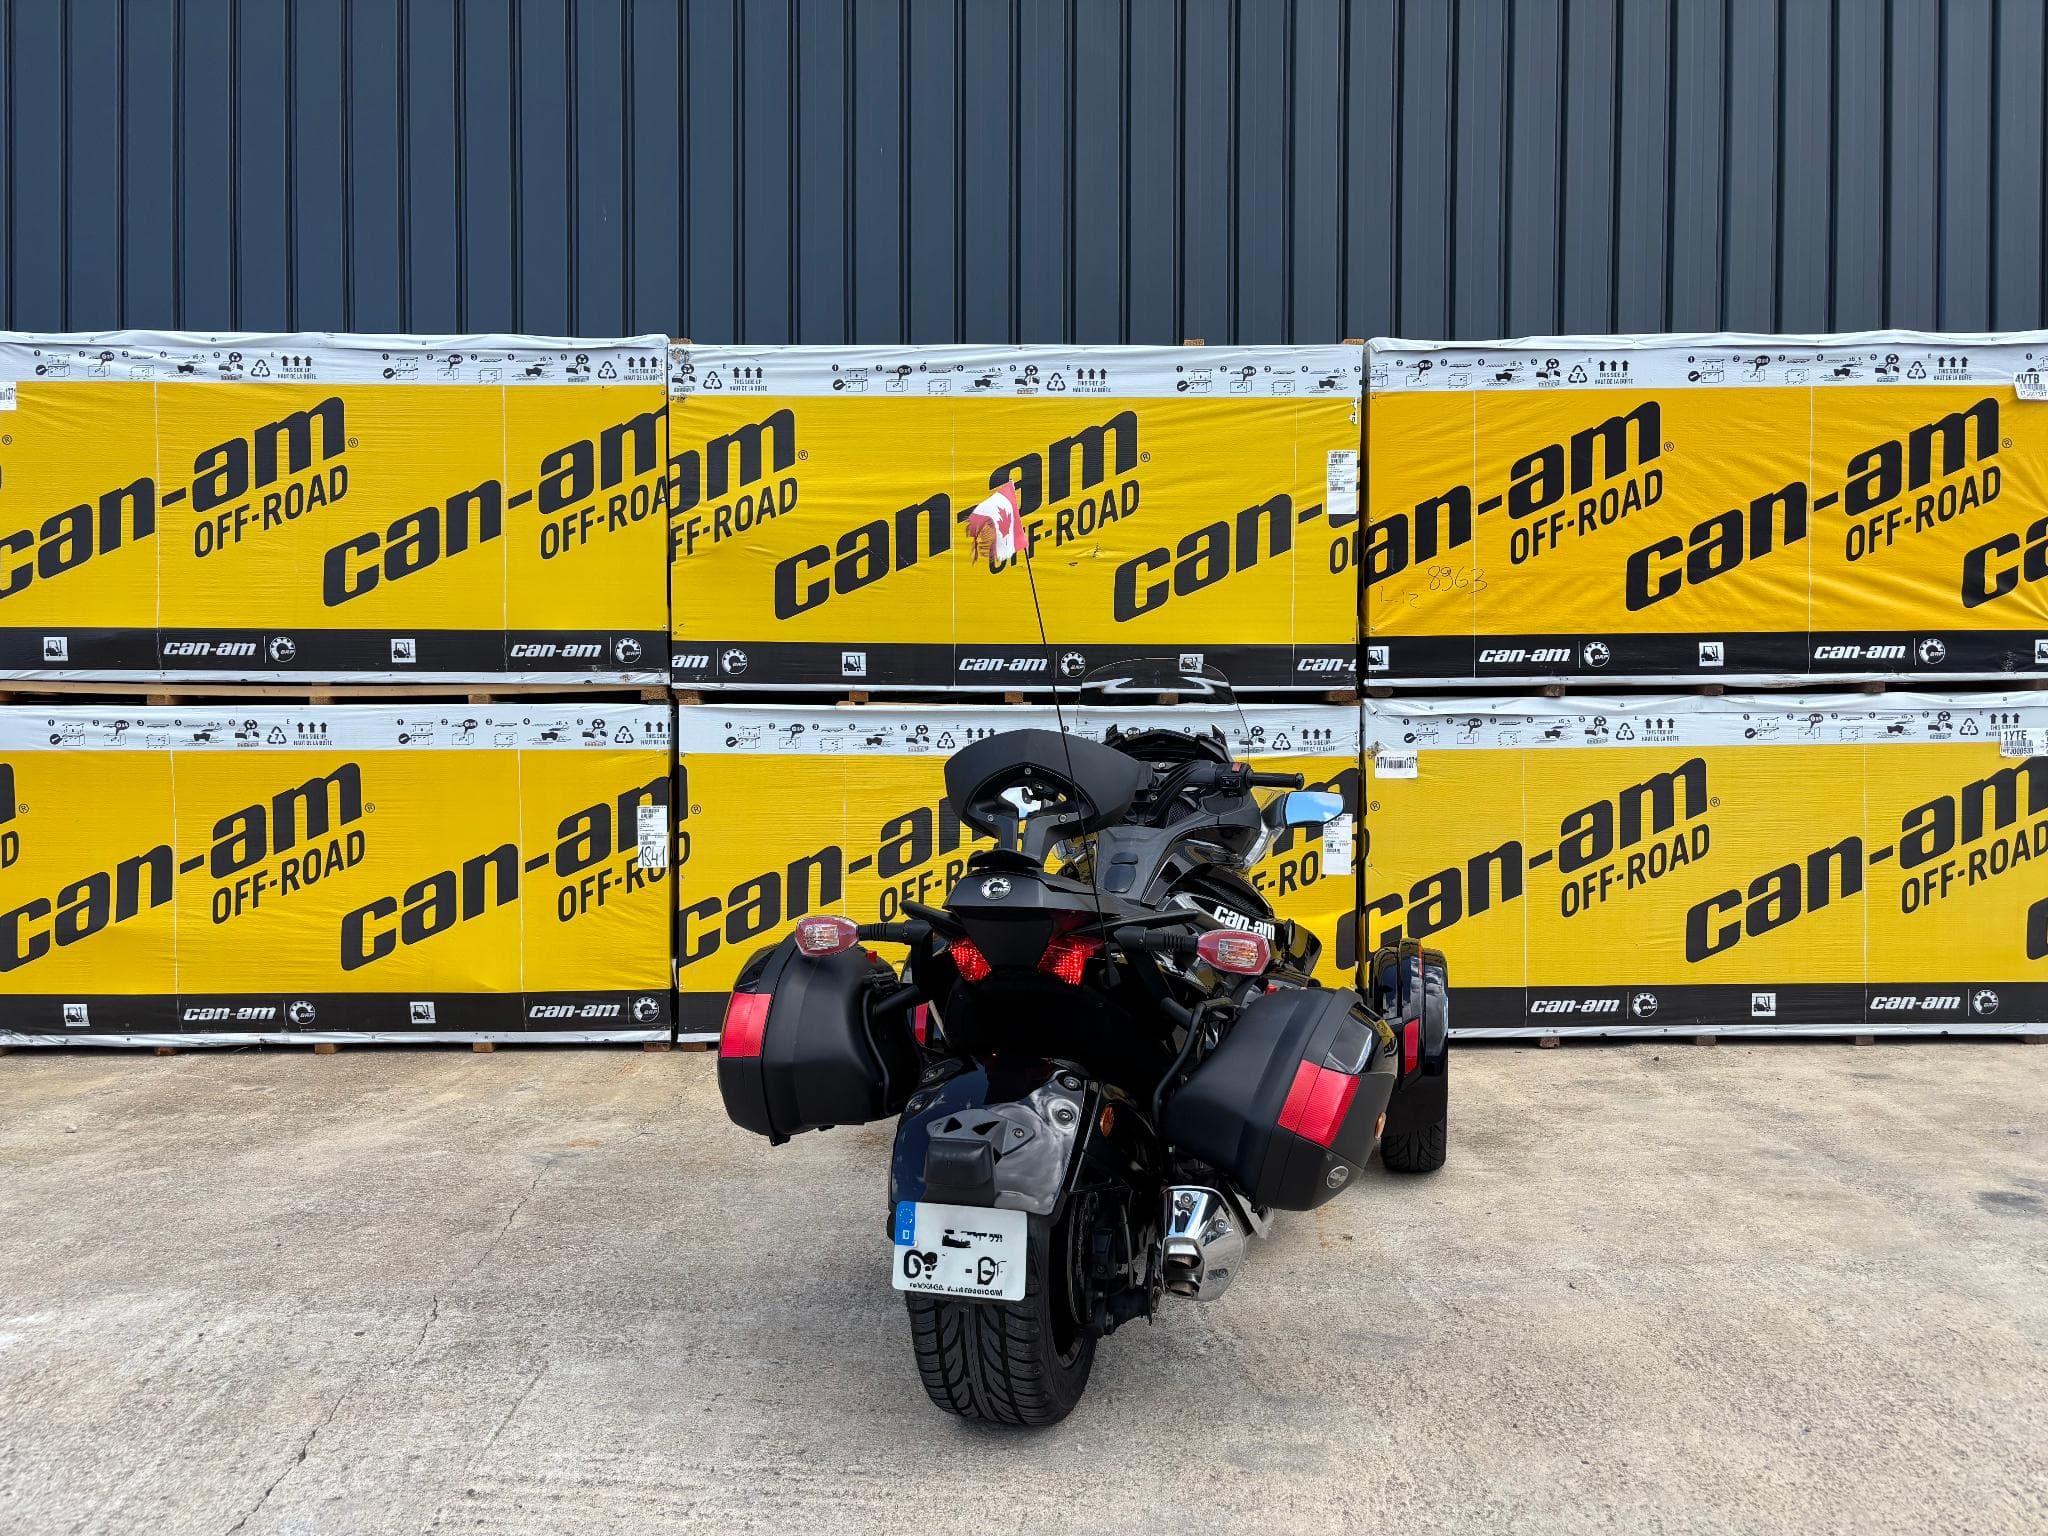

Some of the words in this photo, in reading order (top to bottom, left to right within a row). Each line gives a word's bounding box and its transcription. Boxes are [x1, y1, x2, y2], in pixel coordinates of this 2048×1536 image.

[2015, 374, 2040, 384] 4VTB
[0, 397, 345, 599] can-am
[194, 464, 348, 558] OFF-ROAD
[1627, 398, 1999, 611] can-am
[774, 411, 1138, 621] can-am
[1511, 469, 1663, 564] OFF-ROAD
[1846, 466, 2000, 561] OFF-ROAD
[1428, 566, 1488, 594] 8963
[163, 642, 256, 655] can-am
[510, 644, 601, 657] can-am
[1479, 648, 1570, 662] can-am
[1814, 646, 1906, 658] can-am
[959, 658, 1047, 671] can-am
[2003, 730, 2027, 740] 1YTE
[1376, 757, 1386, 768] ATV
[0, 763, 362, 972] can-am
[639, 846, 666, 867] 1841
[1366, 758, 1707, 962] can-am
[1686, 756, 2048, 962] can-am
[1902, 820, 2048, 914] OFF-ROAD
[212, 830, 365, 924] OFF-ROAD
[1561, 824, 1710, 918] OFF-ROAD
[1214, 905, 1275, 940] can-am
[184, 1007, 276, 1020] can-am
[529, 1005, 620, 1017] can-am
[1530, 1000, 1620, 1012] can-am
[1870, 997, 1960, 1009] can-am
